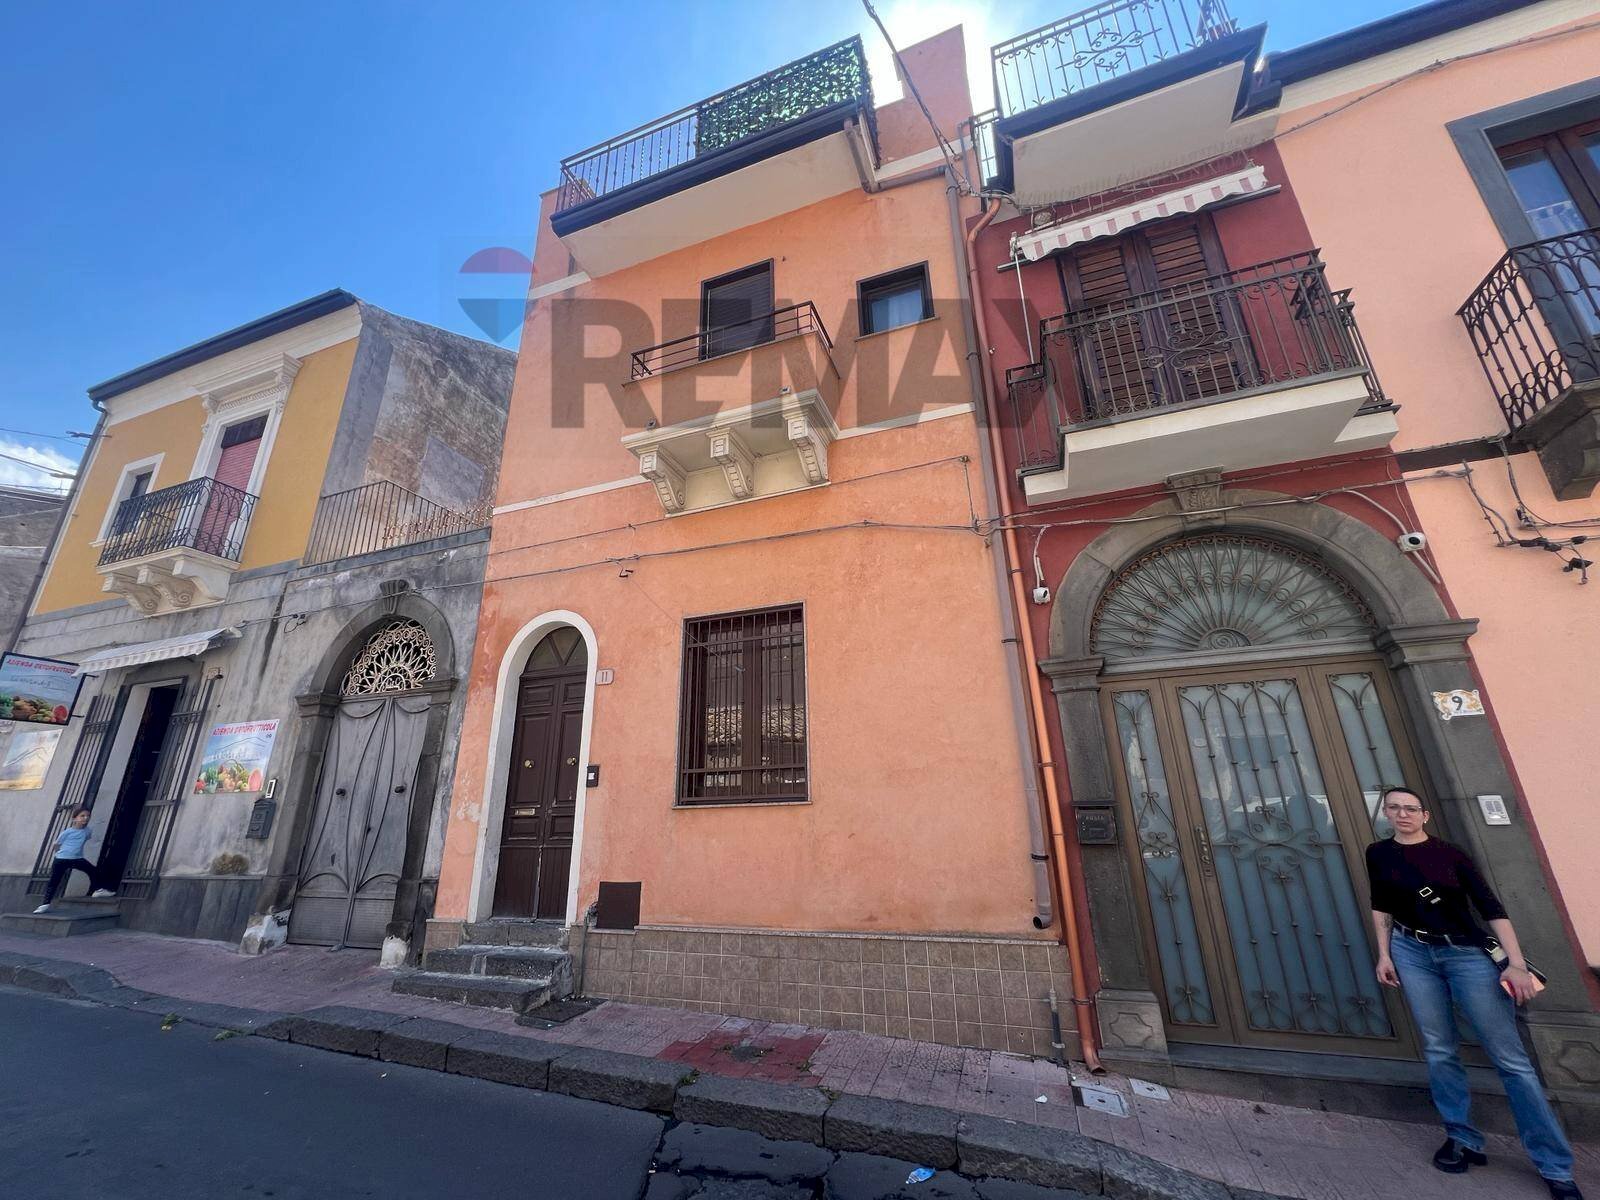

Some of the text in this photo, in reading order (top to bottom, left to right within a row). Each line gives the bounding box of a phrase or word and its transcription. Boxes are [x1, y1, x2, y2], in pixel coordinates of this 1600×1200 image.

[7, 659, 33, 667] AZIENDA
[1451, 695, 1463, 711] 9
[212, 727, 233, 736] AZIENDA
